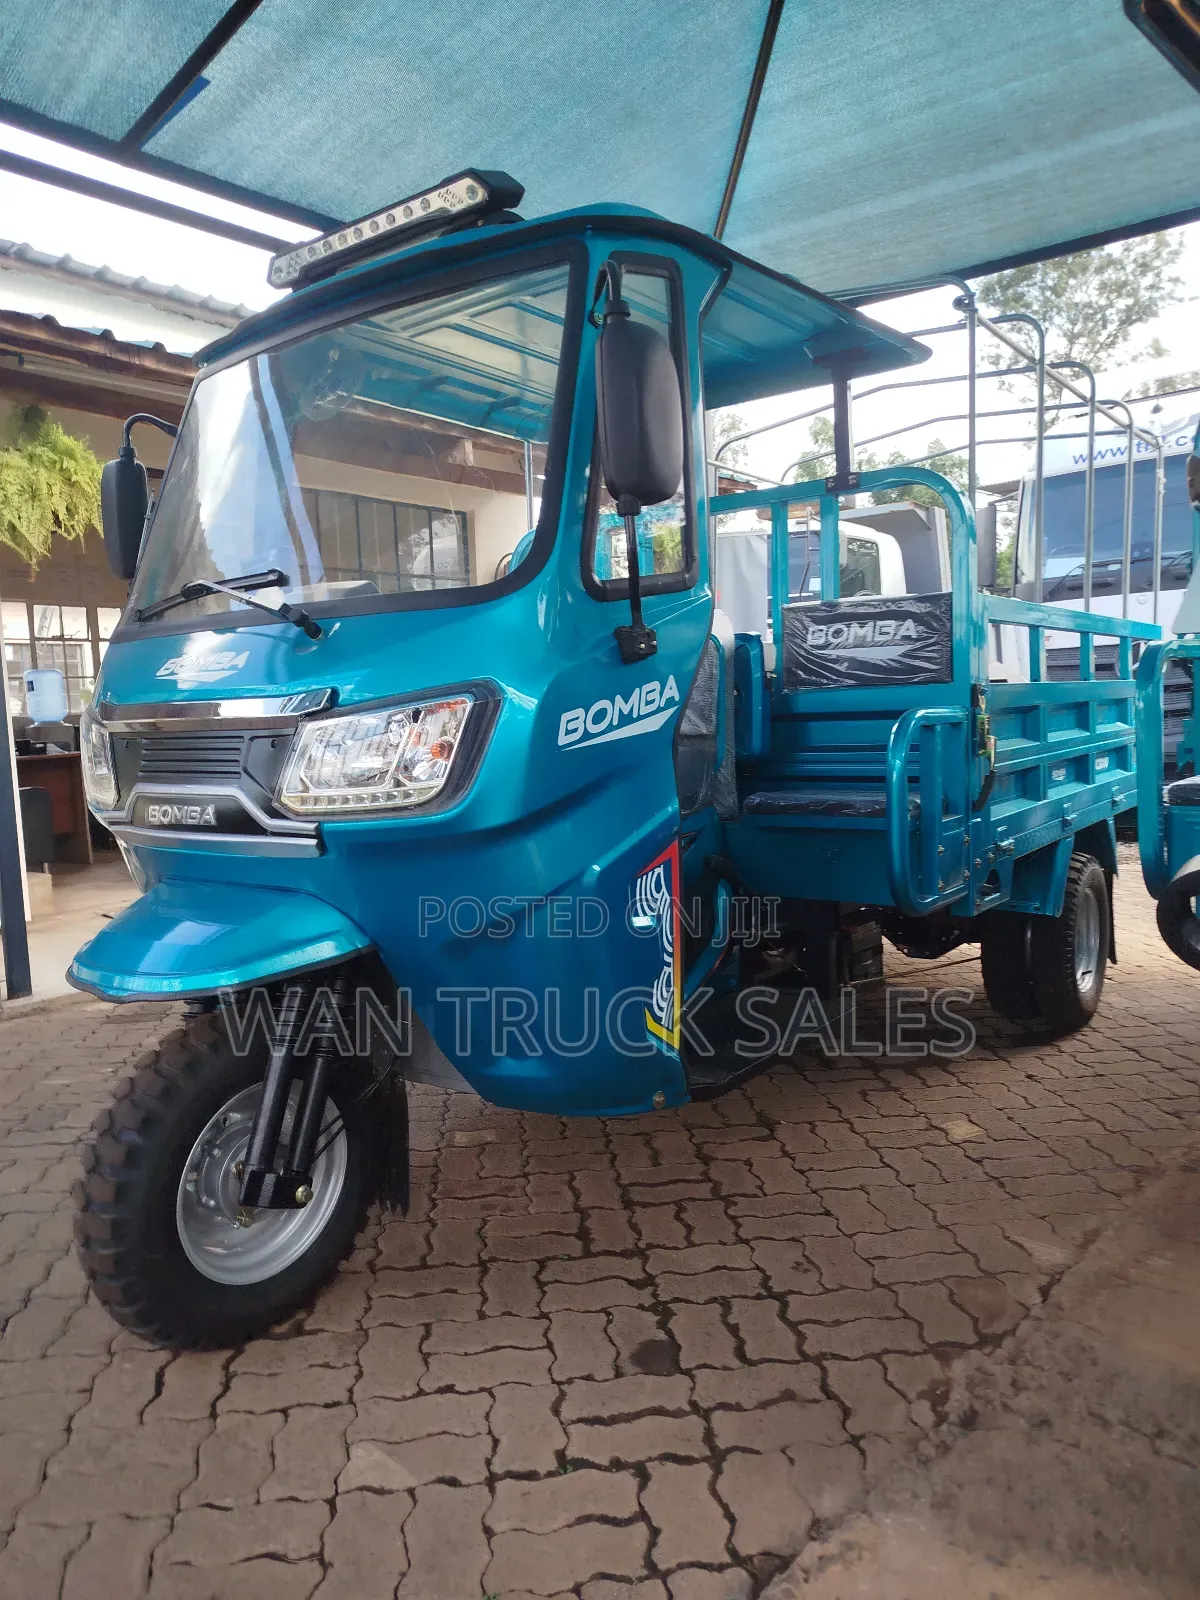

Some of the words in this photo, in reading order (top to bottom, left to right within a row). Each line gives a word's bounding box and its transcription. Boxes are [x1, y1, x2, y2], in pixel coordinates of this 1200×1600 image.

[807, 619, 917, 645] BOMBA
[155, 651, 250, 676] BOMBA
[558, 674, 680, 746] BOMBA
[147, 804, 216, 826] BOMBA
